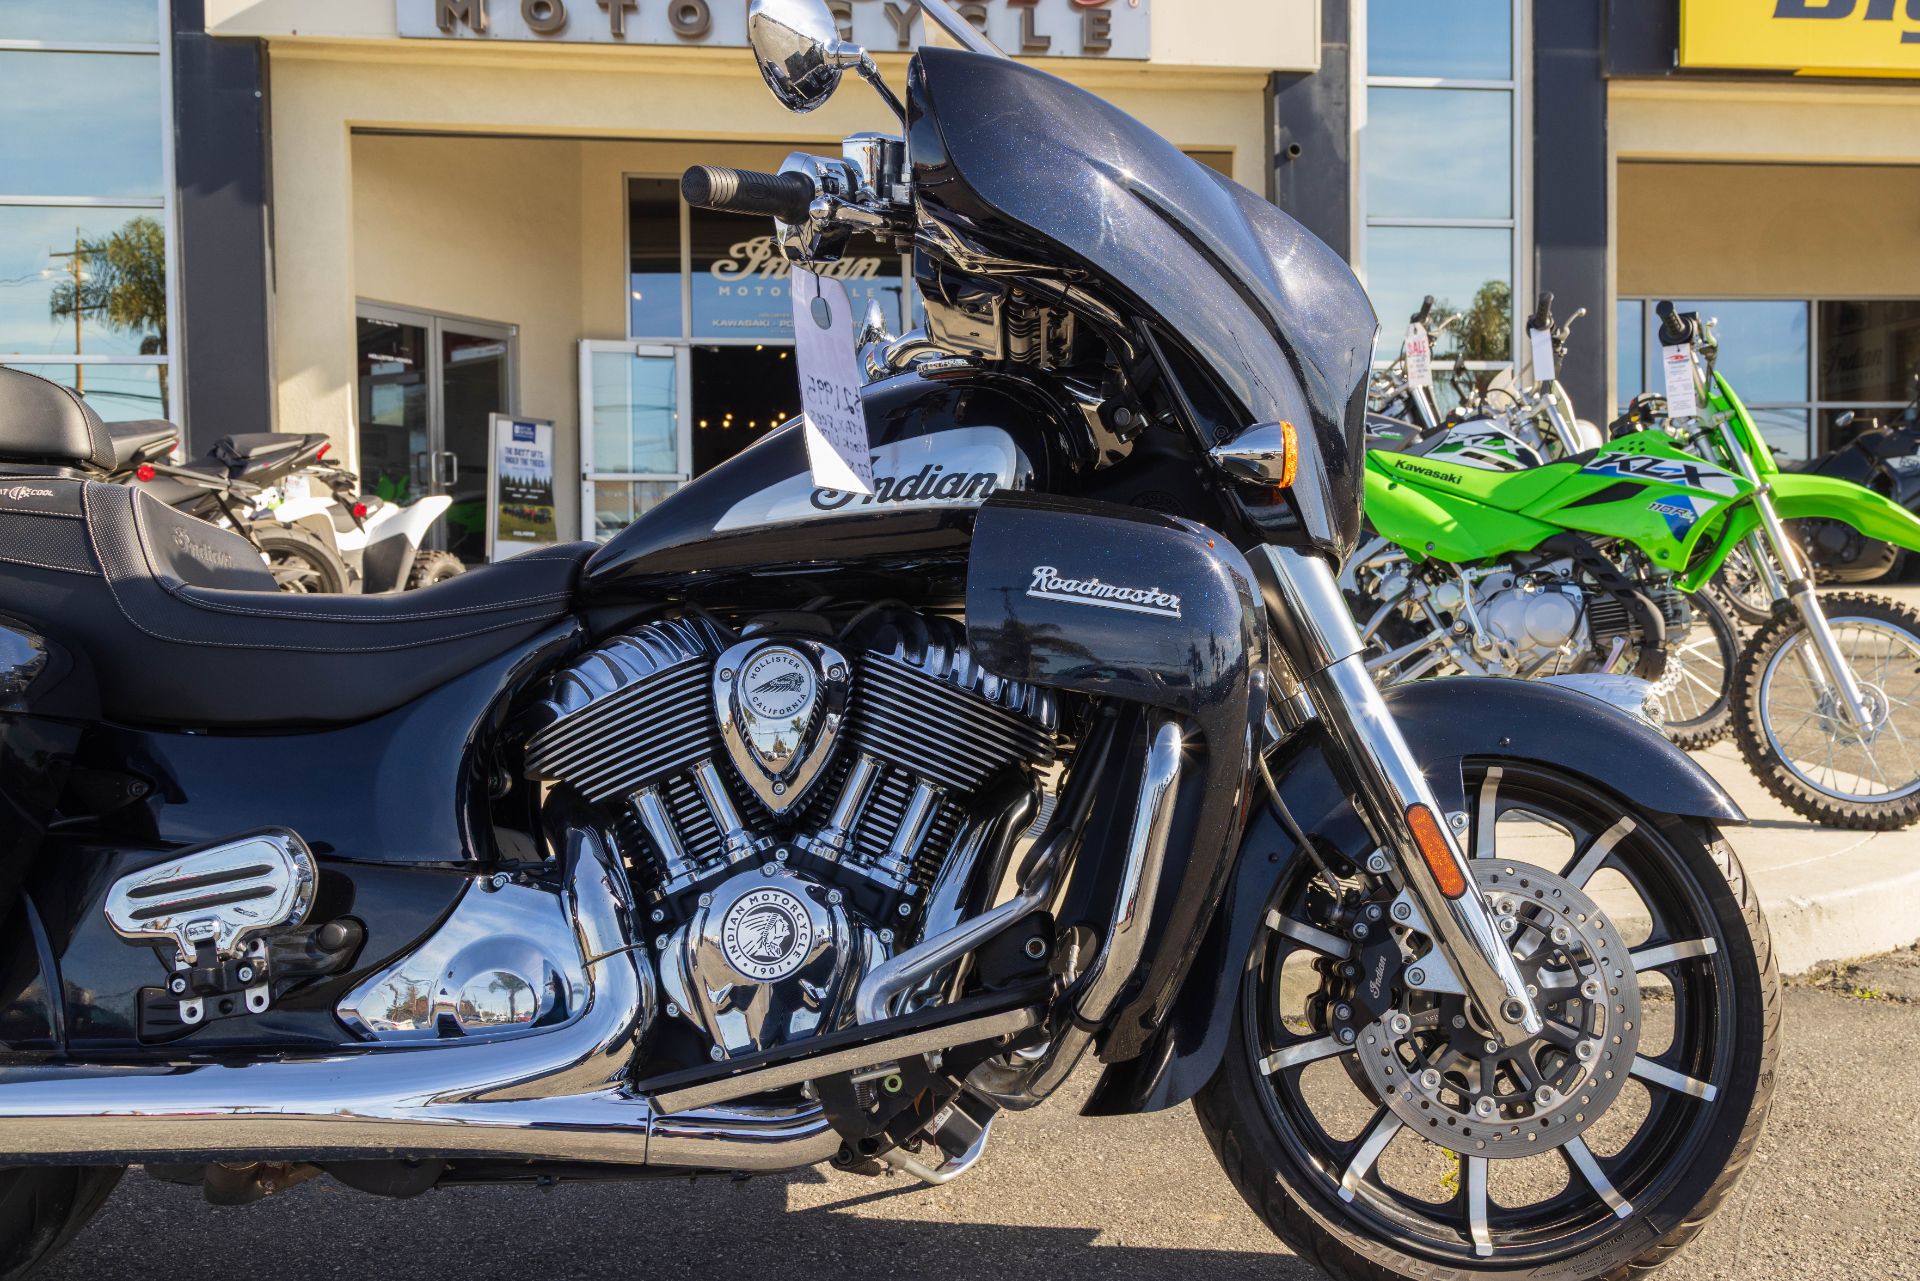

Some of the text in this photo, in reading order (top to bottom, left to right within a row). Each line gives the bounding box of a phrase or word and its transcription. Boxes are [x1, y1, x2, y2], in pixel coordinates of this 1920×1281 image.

[1394, 459, 1464, 486] Kawasaki
[1590, 452, 1734, 491] KLX
[30, 489, 54, 497] COOL
[174, 526, 234, 569] Indian
[1028, 566, 1182, 610] Roadmaster
[750, 656, 801, 680] HOLLISTER
[752, 693, 807, 715] CALIFORNIA
[727, 893, 808, 961] INDIAN MOTORCYCLE
[752, 965, 783, 975] 1901
[1369, 955, 1387, 999] Indian
